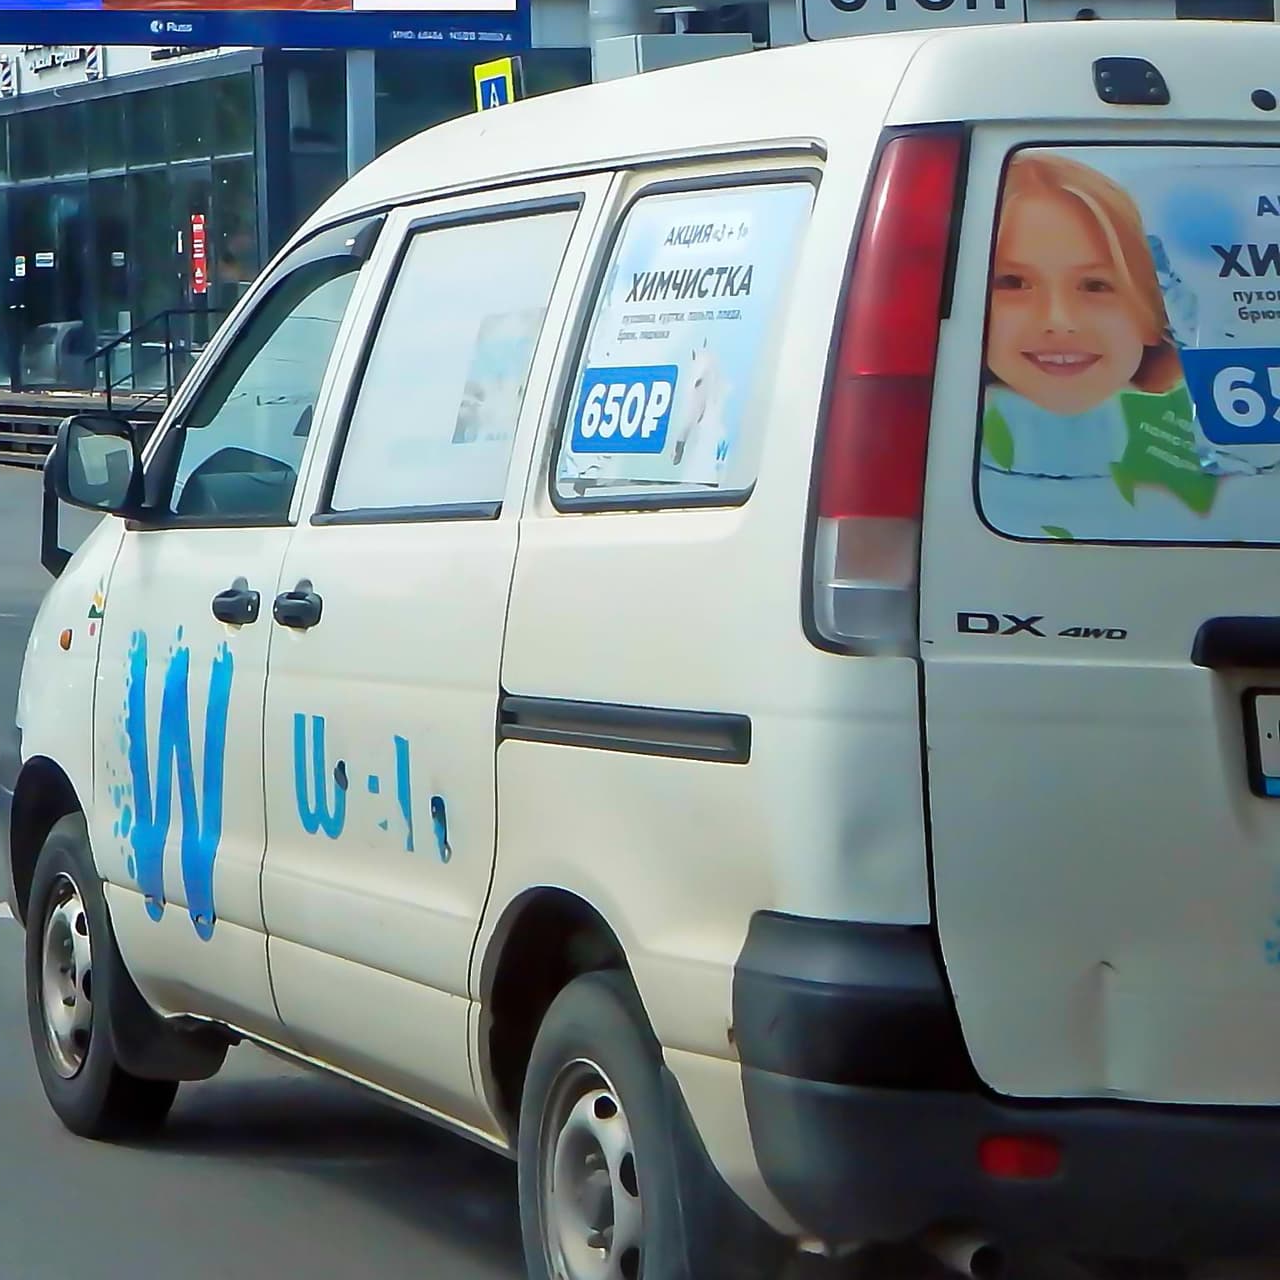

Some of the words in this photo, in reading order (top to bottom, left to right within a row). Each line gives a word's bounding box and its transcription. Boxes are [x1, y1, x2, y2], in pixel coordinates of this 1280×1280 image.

[664, 224, 714, 248] АКЦИЯ
[625, 265, 754, 303] ХИМЧИСТКА
[957, 612, 1047, 637] DX
[1057, 627, 1128, 640] 4WD
